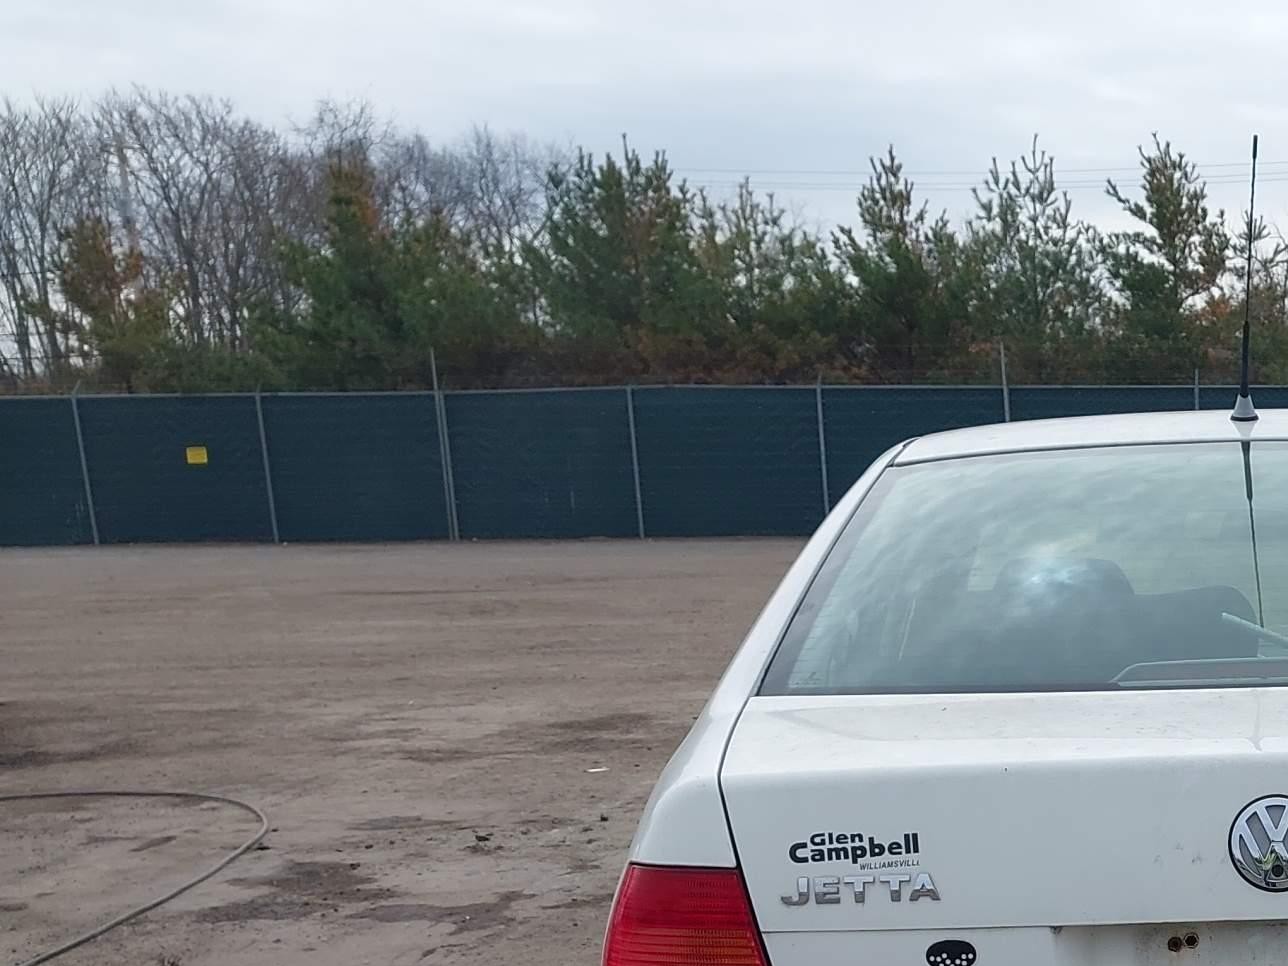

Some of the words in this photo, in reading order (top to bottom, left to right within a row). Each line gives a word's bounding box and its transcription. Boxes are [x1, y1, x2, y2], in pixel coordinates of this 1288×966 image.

[789, 833, 919, 864] Campbell
[810, 832, 863, 846] Glen
[780, 873, 941, 906] JETTA
